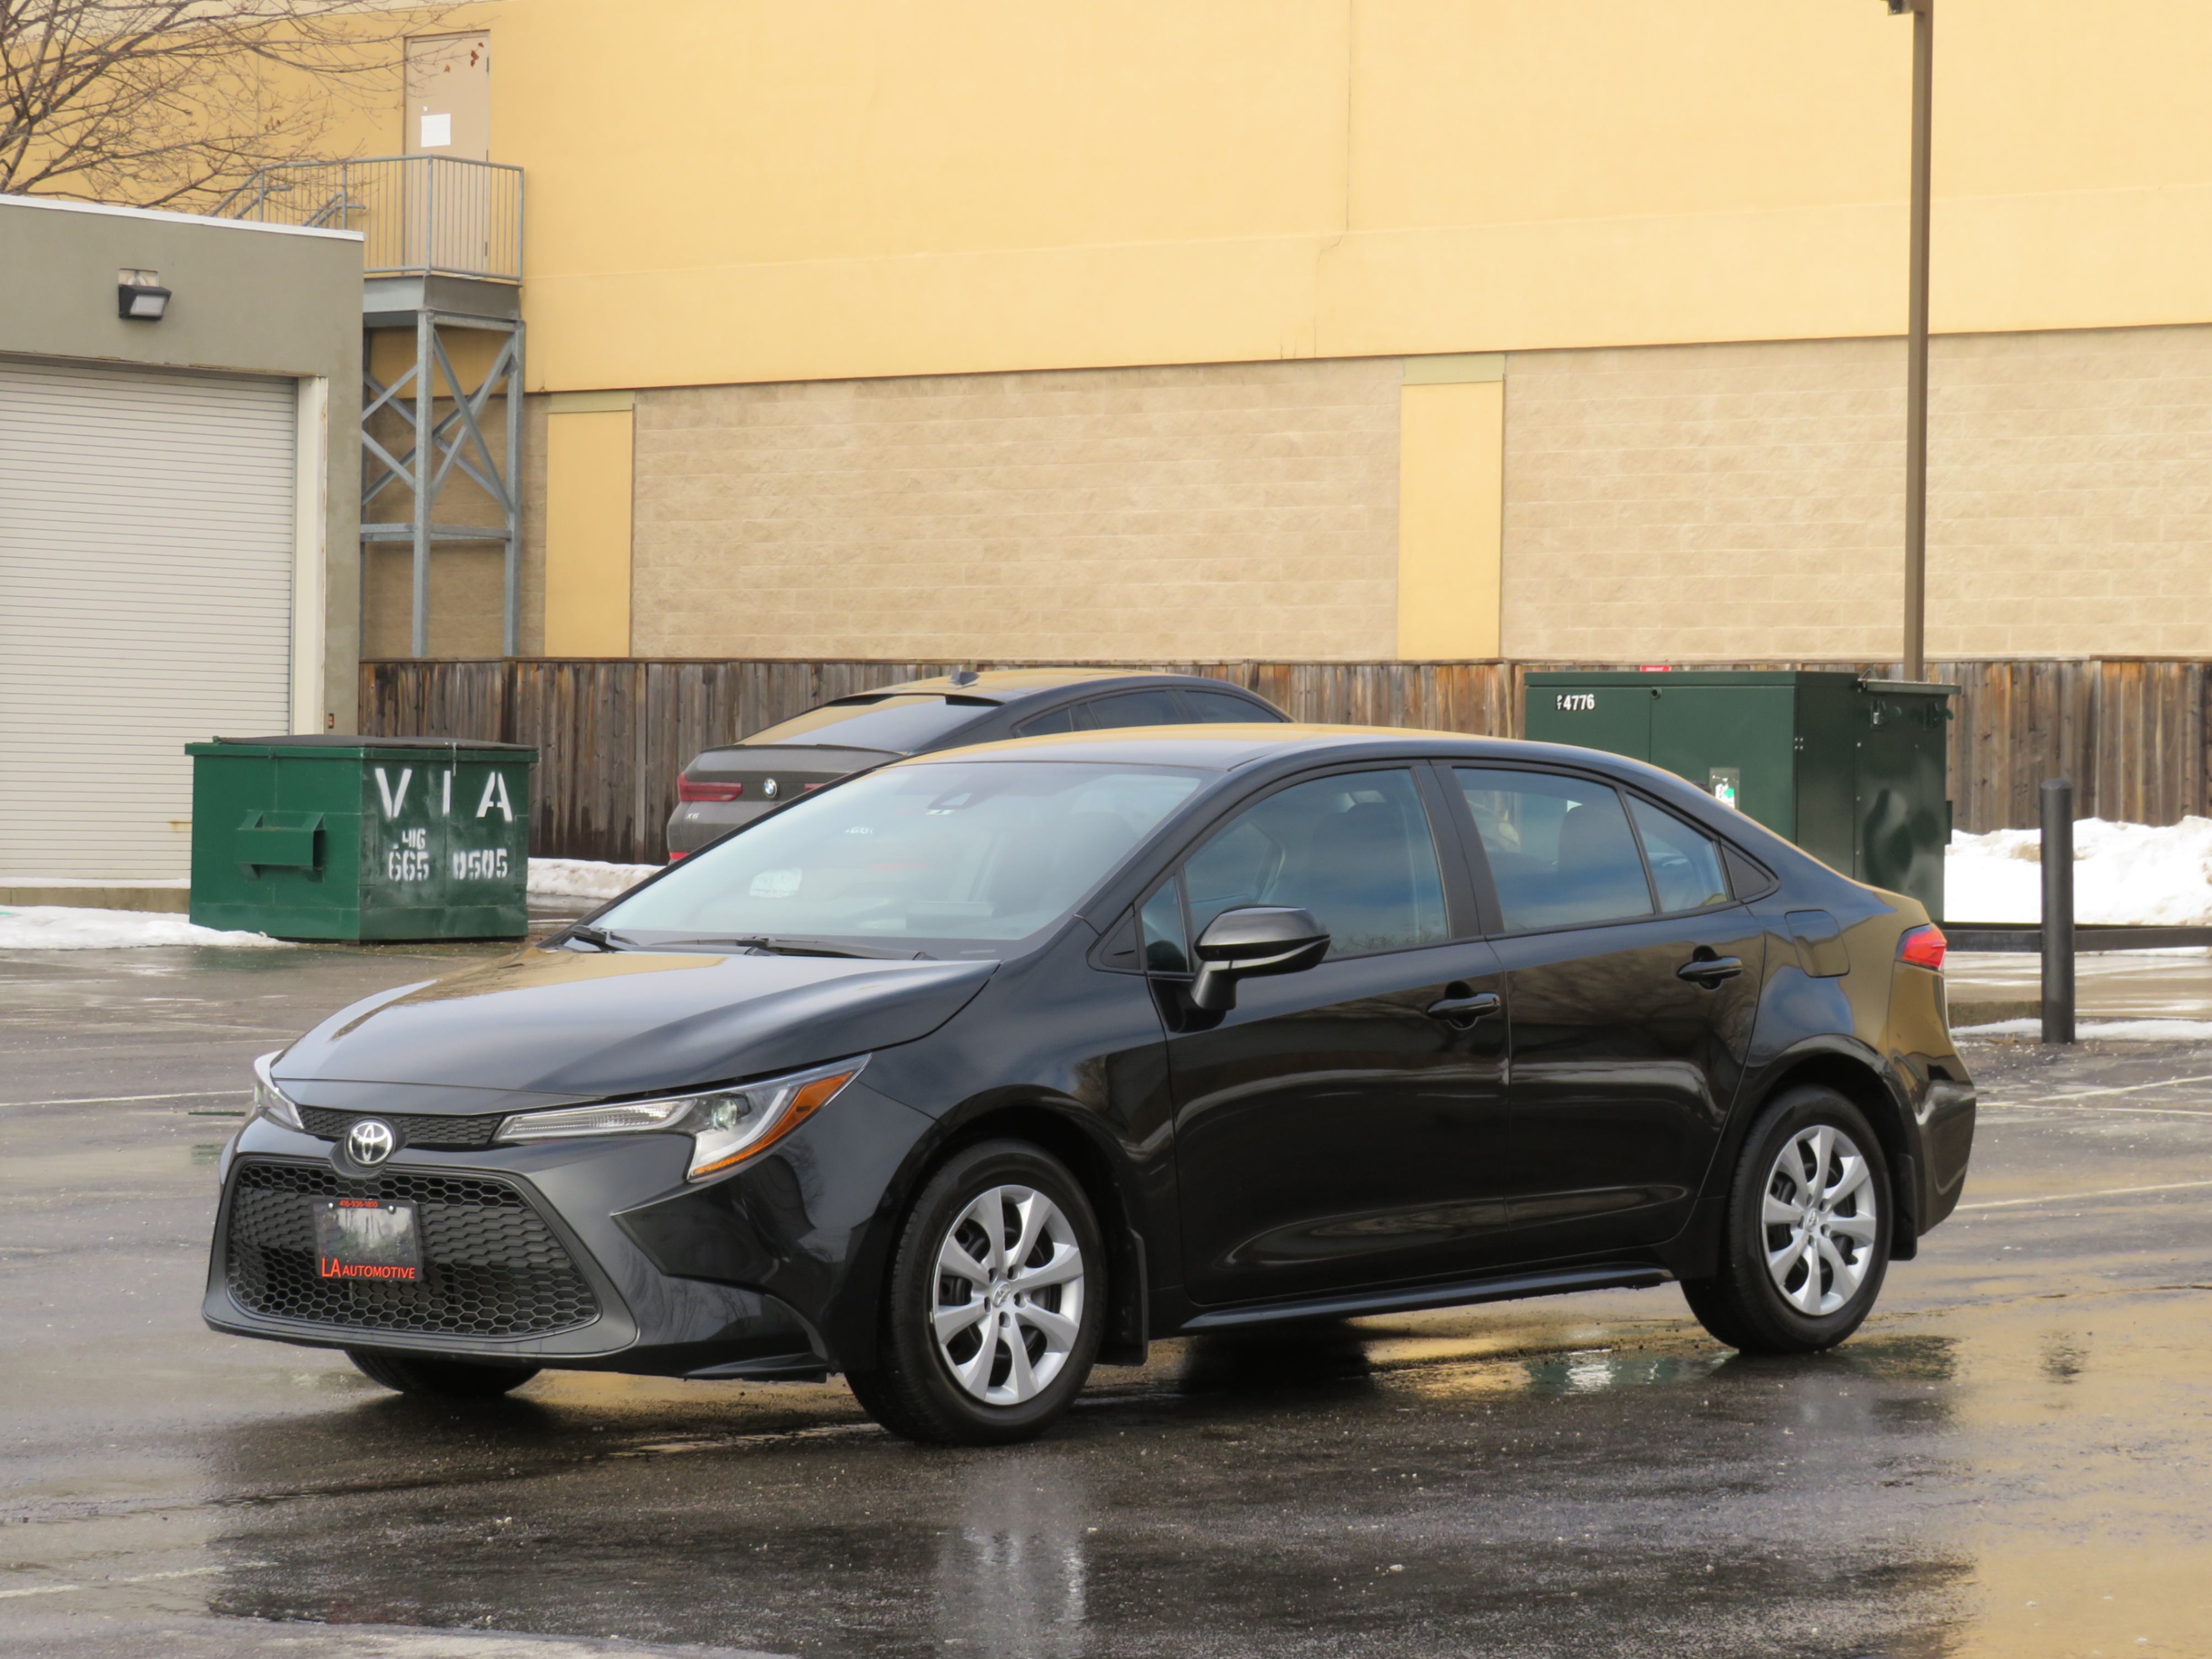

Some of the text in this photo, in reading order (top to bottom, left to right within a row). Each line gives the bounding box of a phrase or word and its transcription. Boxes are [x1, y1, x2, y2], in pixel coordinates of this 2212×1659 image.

[1563, 694, 1595, 711] 4776
[375, 768, 513, 822] VIA
[686, 812, 700, 821] X6
[402, 828, 426, 850] 416
[388, 848, 508, 881] 665 0505
[321, 1258, 415, 1279] LA AUTOMOTIVE
